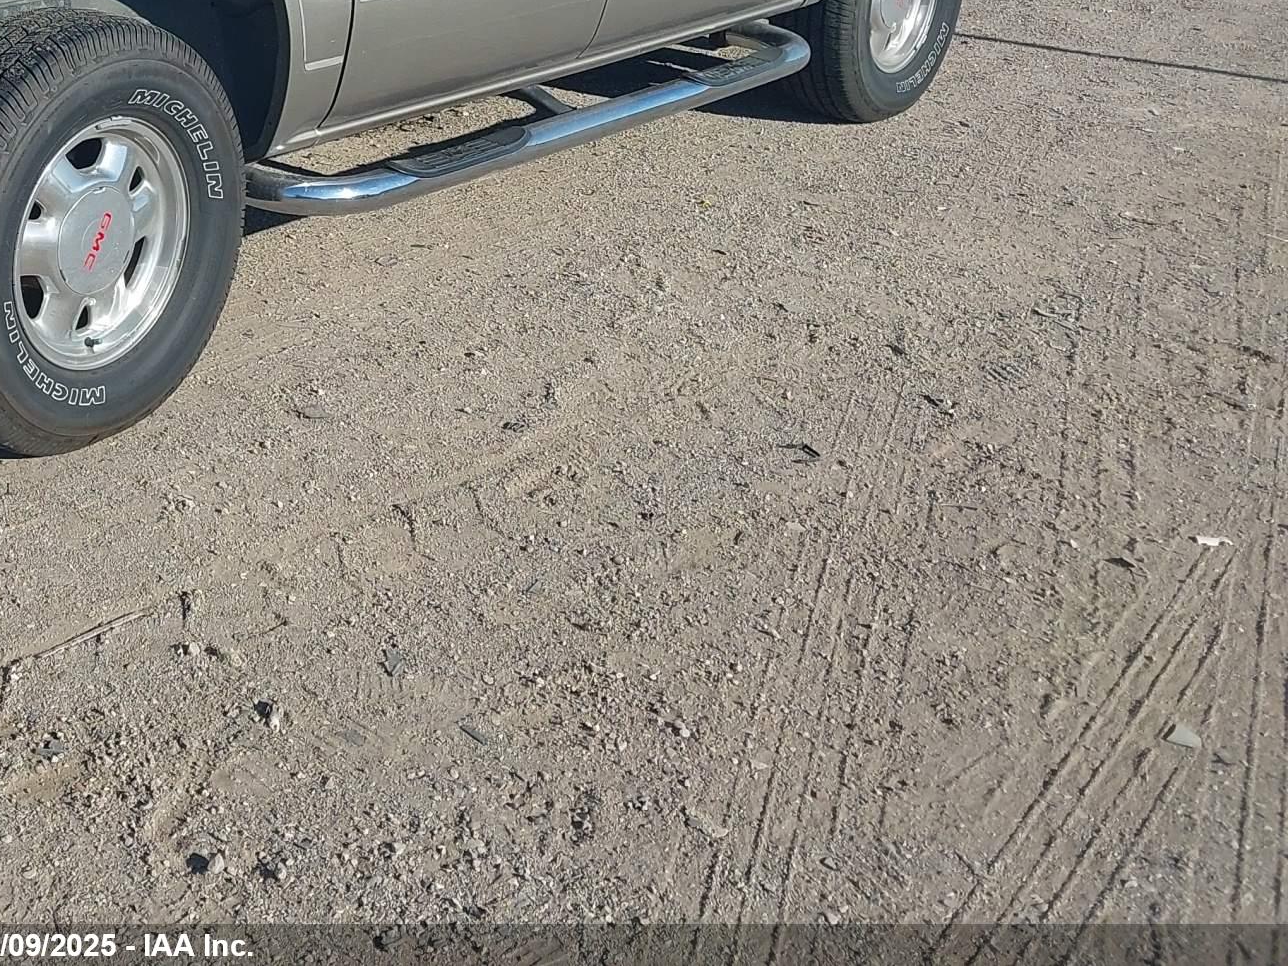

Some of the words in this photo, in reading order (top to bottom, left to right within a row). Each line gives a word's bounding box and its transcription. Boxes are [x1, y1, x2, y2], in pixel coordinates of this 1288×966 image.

[895, 22, 950, 93] MICHELIN
[128, 89, 224, 199] MICHELIN
[83, 212, 112, 272] GMC
[4, 301, 106, 406] MICHELIN
